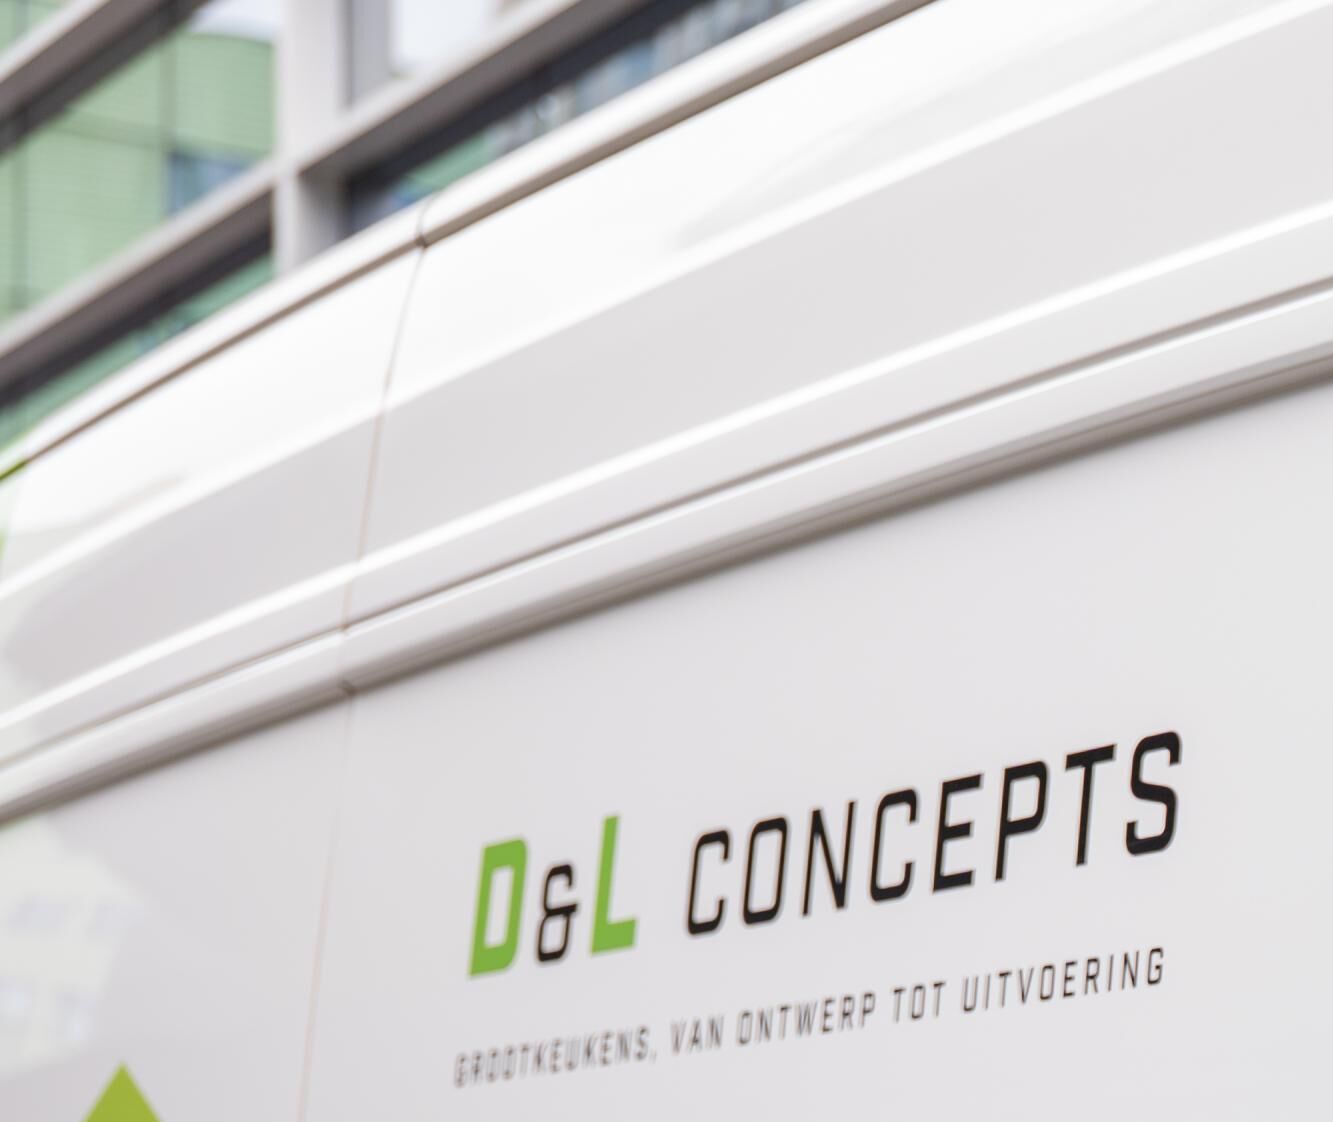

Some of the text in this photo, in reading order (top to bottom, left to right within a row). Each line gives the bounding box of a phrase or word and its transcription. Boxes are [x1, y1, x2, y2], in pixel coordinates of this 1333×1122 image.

[466, 729, 1184, 980] D&L CONCEPTS
[453, 946, 1166, 1088] GROOTKEUKENS, VAN ONTWERP TOT UITVOERING
